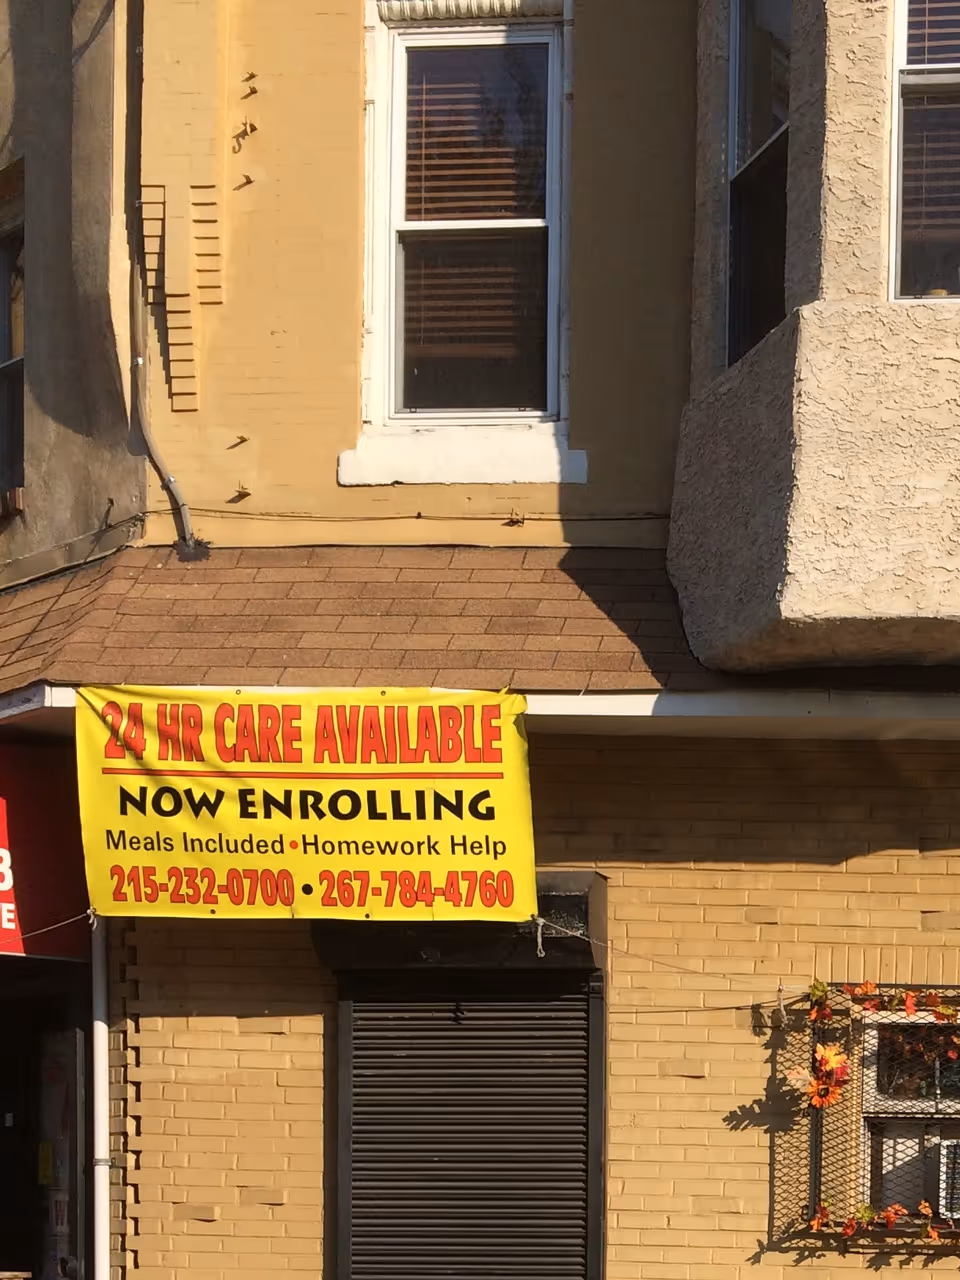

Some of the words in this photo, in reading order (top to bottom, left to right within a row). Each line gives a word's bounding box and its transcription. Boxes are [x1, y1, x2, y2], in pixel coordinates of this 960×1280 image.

[101, 700, 147, 761] 24
[156, 702, 204, 762] HR
[214, 702, 302, 764] CARE
[313, 704, 503, 765] AVAILABLE
[119, 785, 225, 819] NOW
[239, 789, 496, 821] ENROLLING
[105, 829, 175, 854] Meals
[302, 834, 440, 856] Homework
[450, 835, 507, 860] Help
[110, 864, 294, 906] 215-232-0700
[318, 869, 514, 908] 267-784-4760
